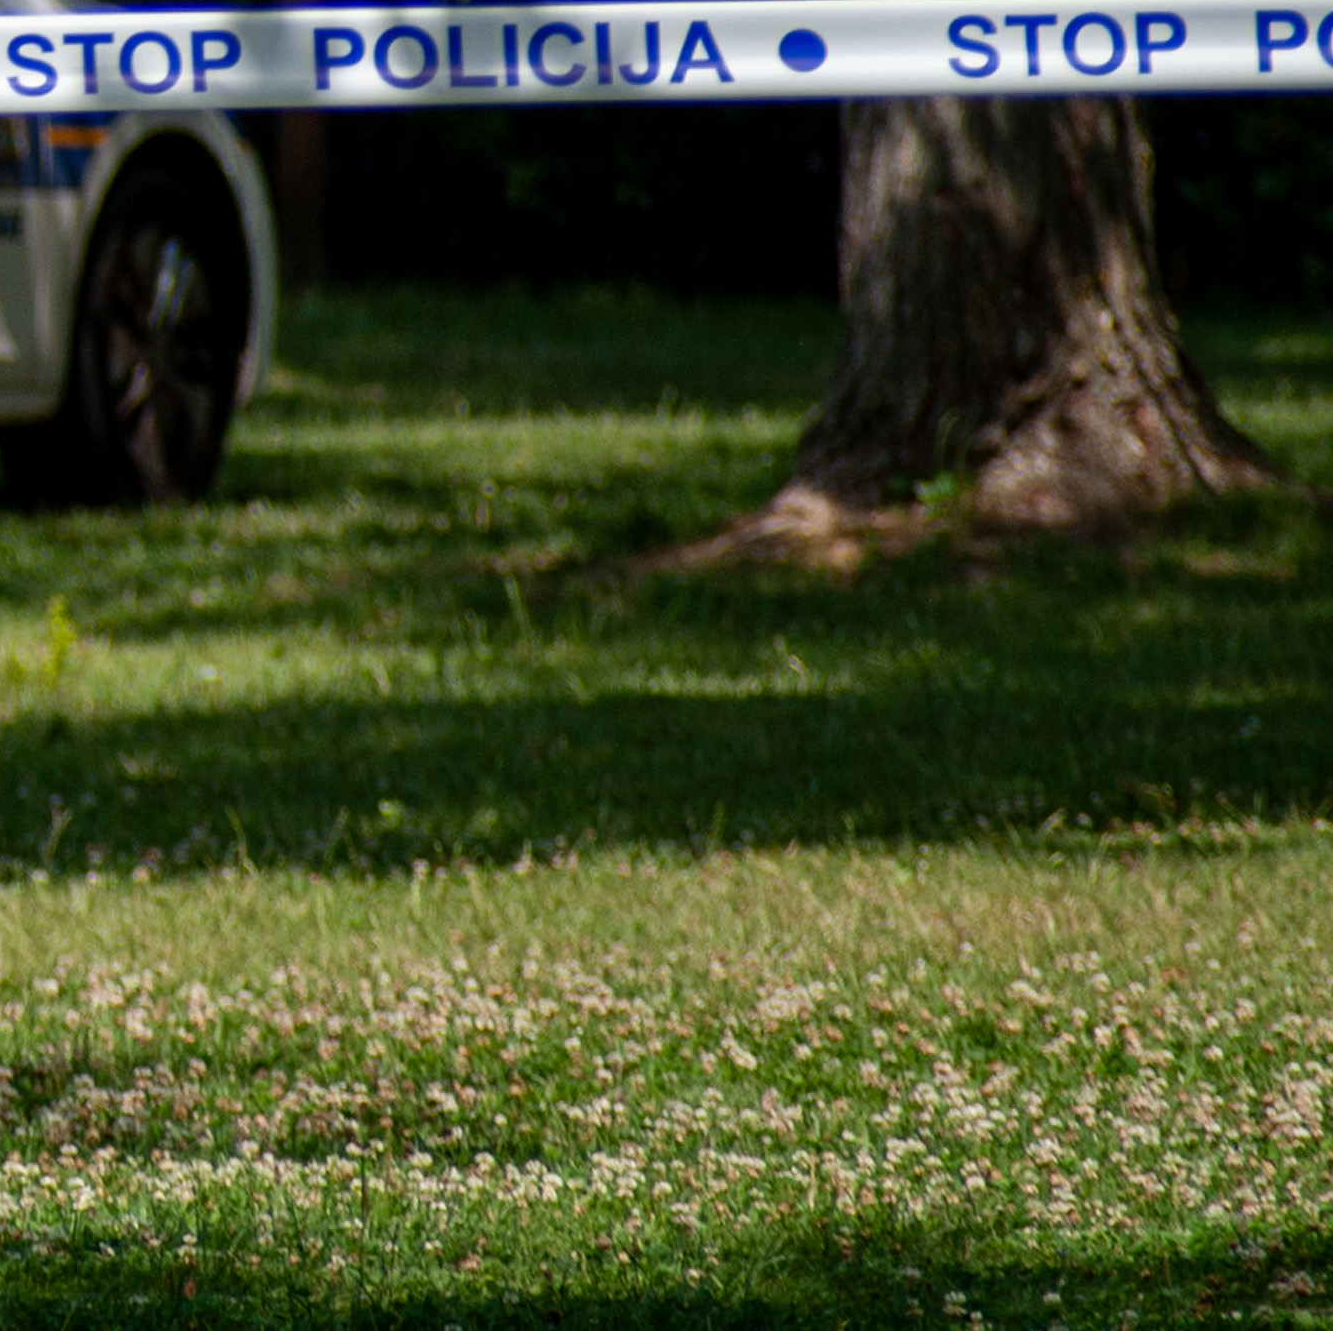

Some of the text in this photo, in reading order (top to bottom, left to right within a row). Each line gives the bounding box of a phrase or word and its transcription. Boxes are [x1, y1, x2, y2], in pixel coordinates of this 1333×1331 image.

[6, 29, 242, 97] STOP
[312, 19, 734, 91] POLICIJA
[947, 11, 1187, 79] STOP
[1254, 8, 1333, 73] P
